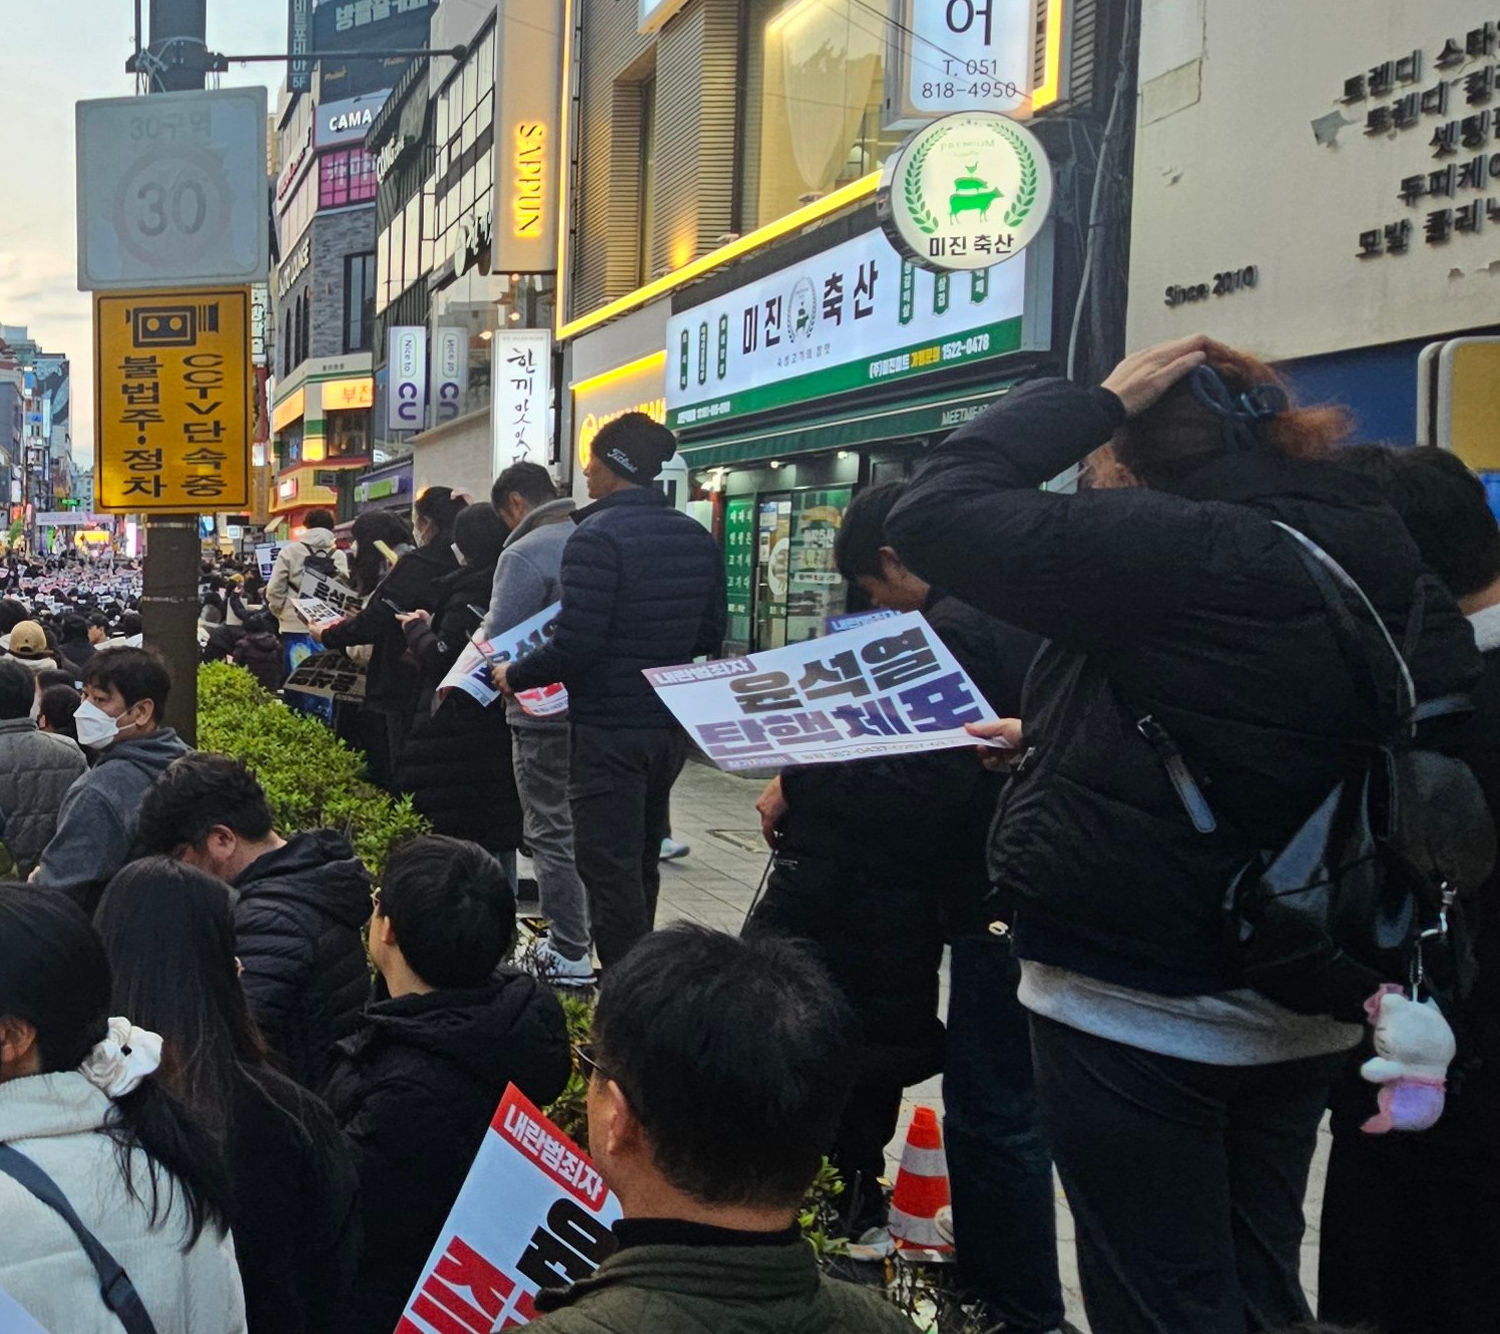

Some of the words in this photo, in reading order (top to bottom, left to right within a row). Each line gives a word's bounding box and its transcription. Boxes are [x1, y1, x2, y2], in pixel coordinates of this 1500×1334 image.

[966, 59, 998, 75] 051
[922, 82, 1016, 99] 818-4950
[329, 108, 372, 131] CAMA
[513, 122, 544, 238] SAPPUN
[138, 180, 206, 237] 30
[930, 236, 967, 257] 미진
[974, 234, 1015, 255] 축산
[743, 295, 782, 355] 미진
[823, 259, 879, 326] 축산
[942, 333, 990, 361] 1522-0478
[398, 382, 417, 420] CU
[729, 627, 942, 715] 윤석열
[504, 1104, 604, 1202] 내란범죄자
